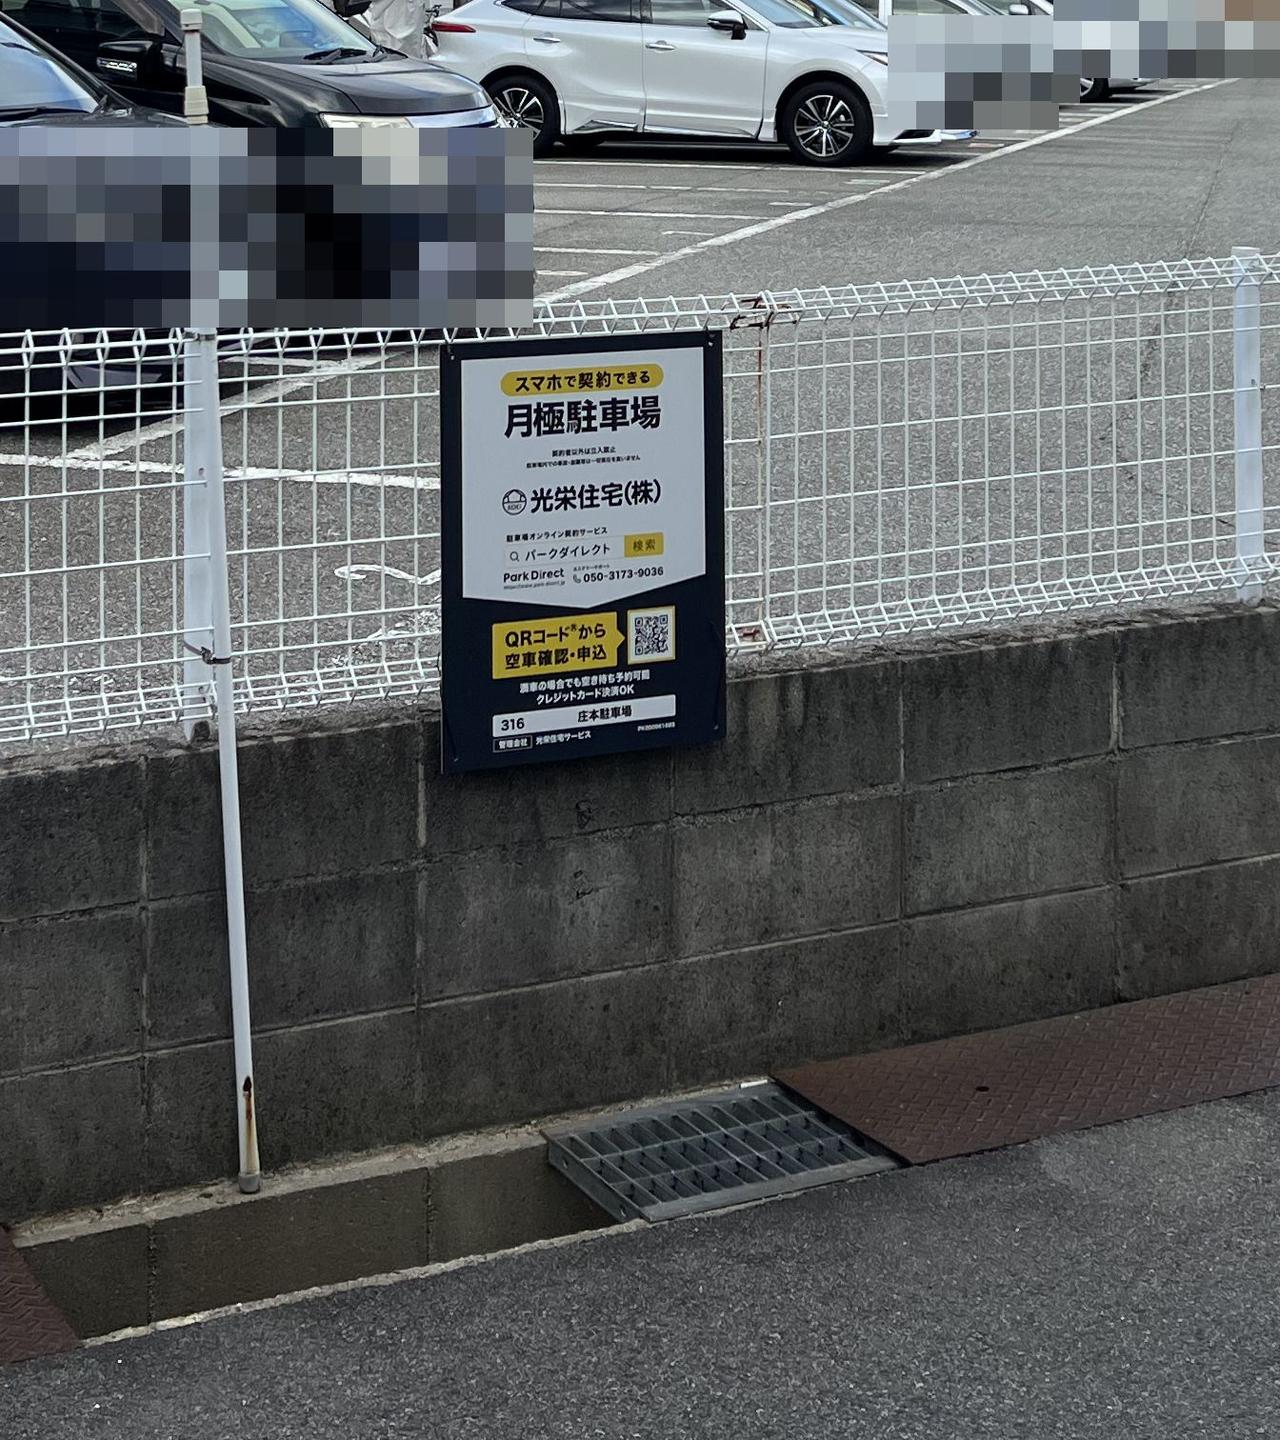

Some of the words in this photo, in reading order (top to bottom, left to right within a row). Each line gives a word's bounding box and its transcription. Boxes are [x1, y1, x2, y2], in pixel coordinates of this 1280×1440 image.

[515, 370, 651, 392] スマホで契約できる
[504, 395, 662, 439] 月極駐車場
[531, 478, 661, 514] 光栄住宅(株)
[525, 543, 611, 561] パークダイレクト
[632, 538, 656, 553] 検索
[583, 566, 664, 583] 050-3173-9036
[505, 644, 608, 670] 空車確認・申込
[501, 718, 525, 731] 316
